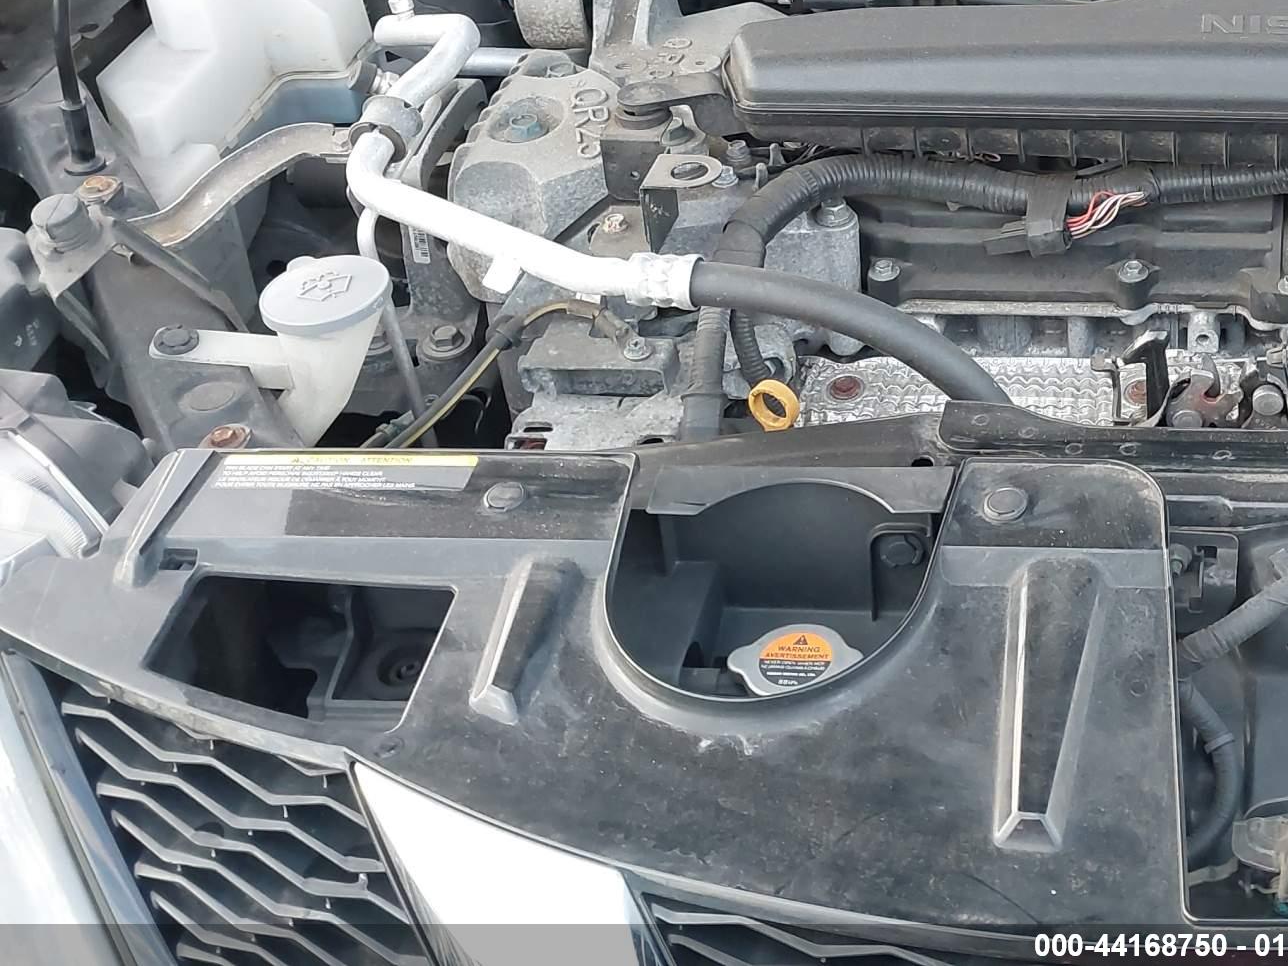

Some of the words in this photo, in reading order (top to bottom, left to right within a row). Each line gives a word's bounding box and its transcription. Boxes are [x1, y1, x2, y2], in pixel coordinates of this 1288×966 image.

[360, 456, 414, 464] ATTENTION
[777, 645, 821, 653] WARNING
[765, 652, 829, 660] AVERTISSEMENT
